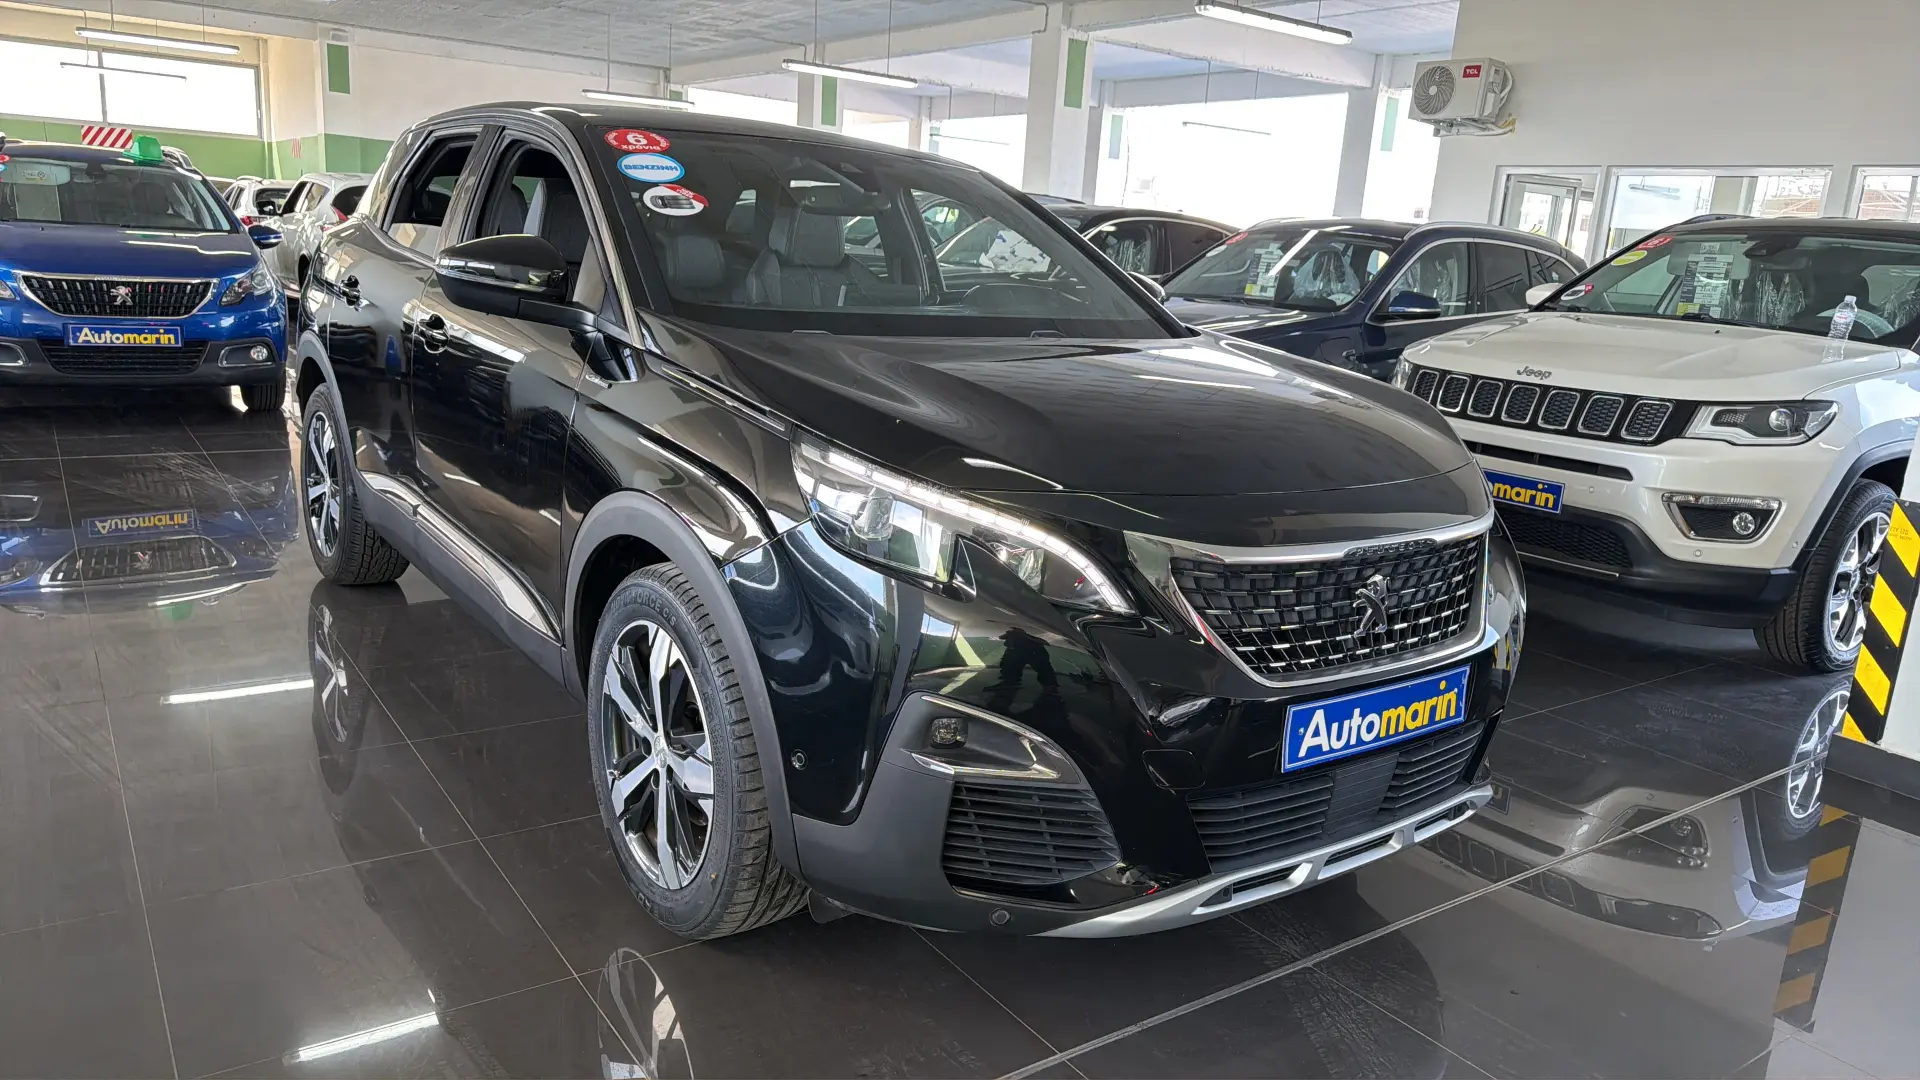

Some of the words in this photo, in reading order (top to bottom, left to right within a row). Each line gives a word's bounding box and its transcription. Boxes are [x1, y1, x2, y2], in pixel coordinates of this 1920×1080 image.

[626, 134, 648, 145] 6
[77, 327, 176, 345] Automarin
[1516, 366, 1553, 380] Jeep
[1297, 679, 1459, 758] Automarin
